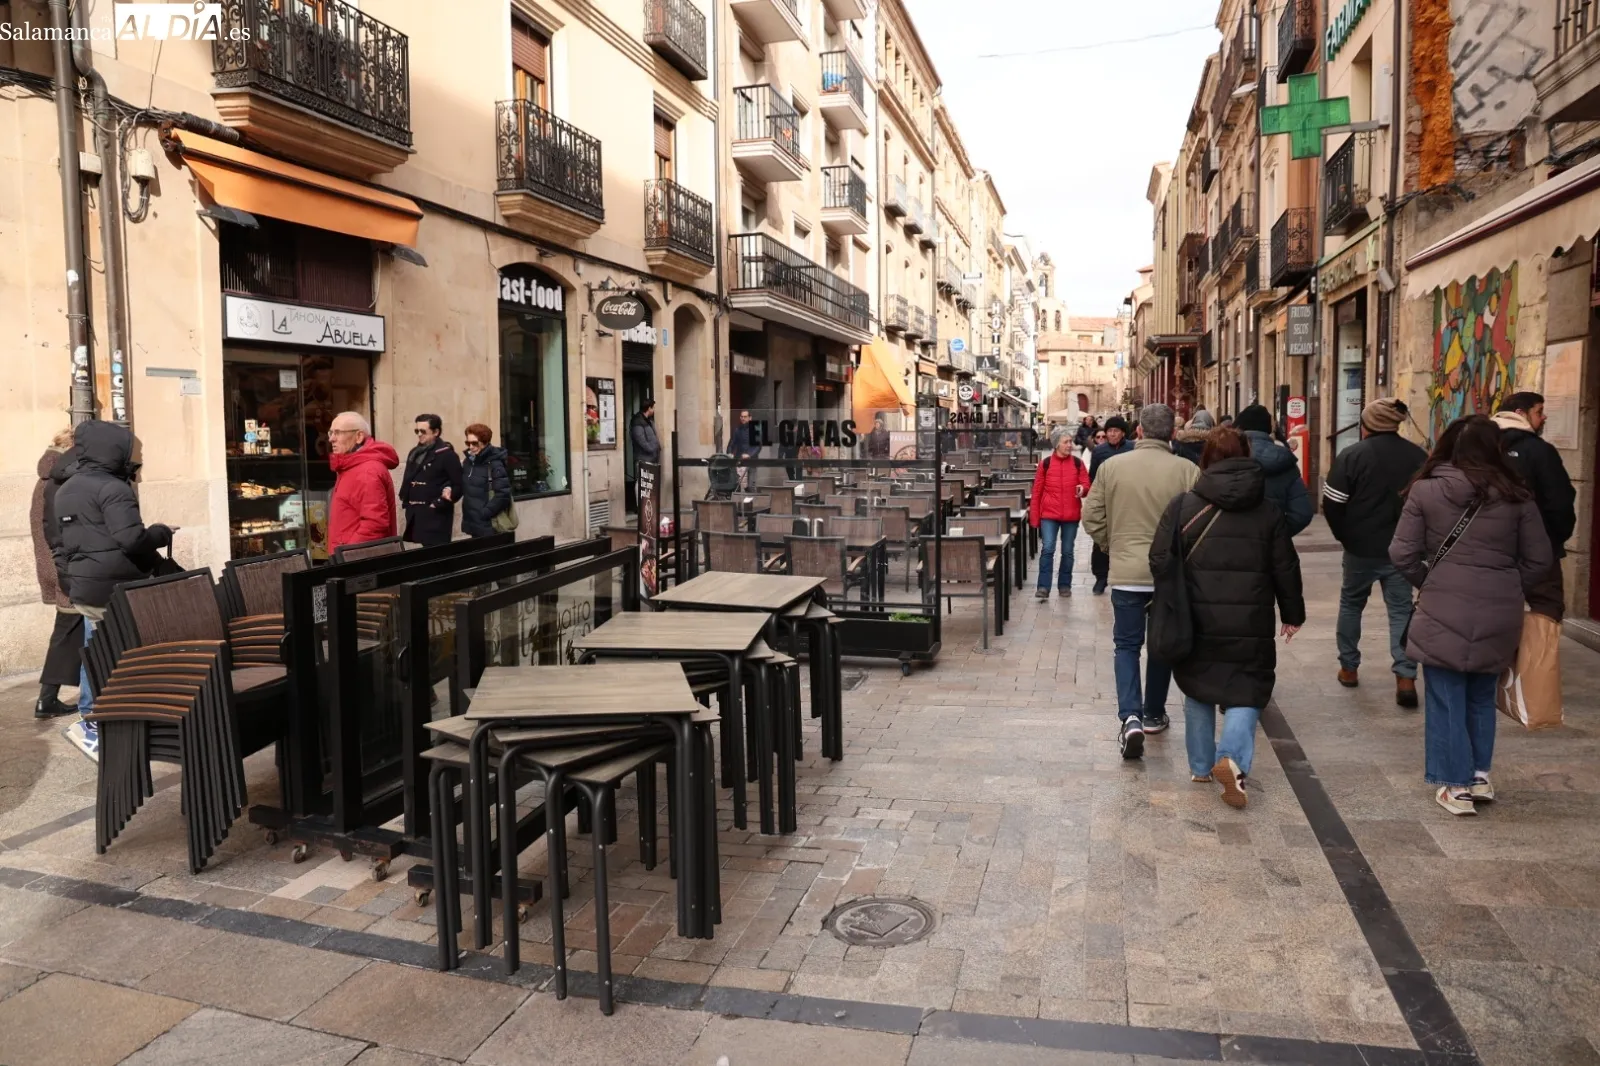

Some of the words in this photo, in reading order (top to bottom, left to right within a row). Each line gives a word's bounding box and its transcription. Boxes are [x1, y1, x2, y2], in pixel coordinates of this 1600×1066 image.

[286, 307, 326, 324] TAHONA
[330, 315, 342, 327] DE
[316, 322, 377, 347] ABUELA
[749, 420, 772, 447] EL
[779, 419, 857, 448] GAFAS
